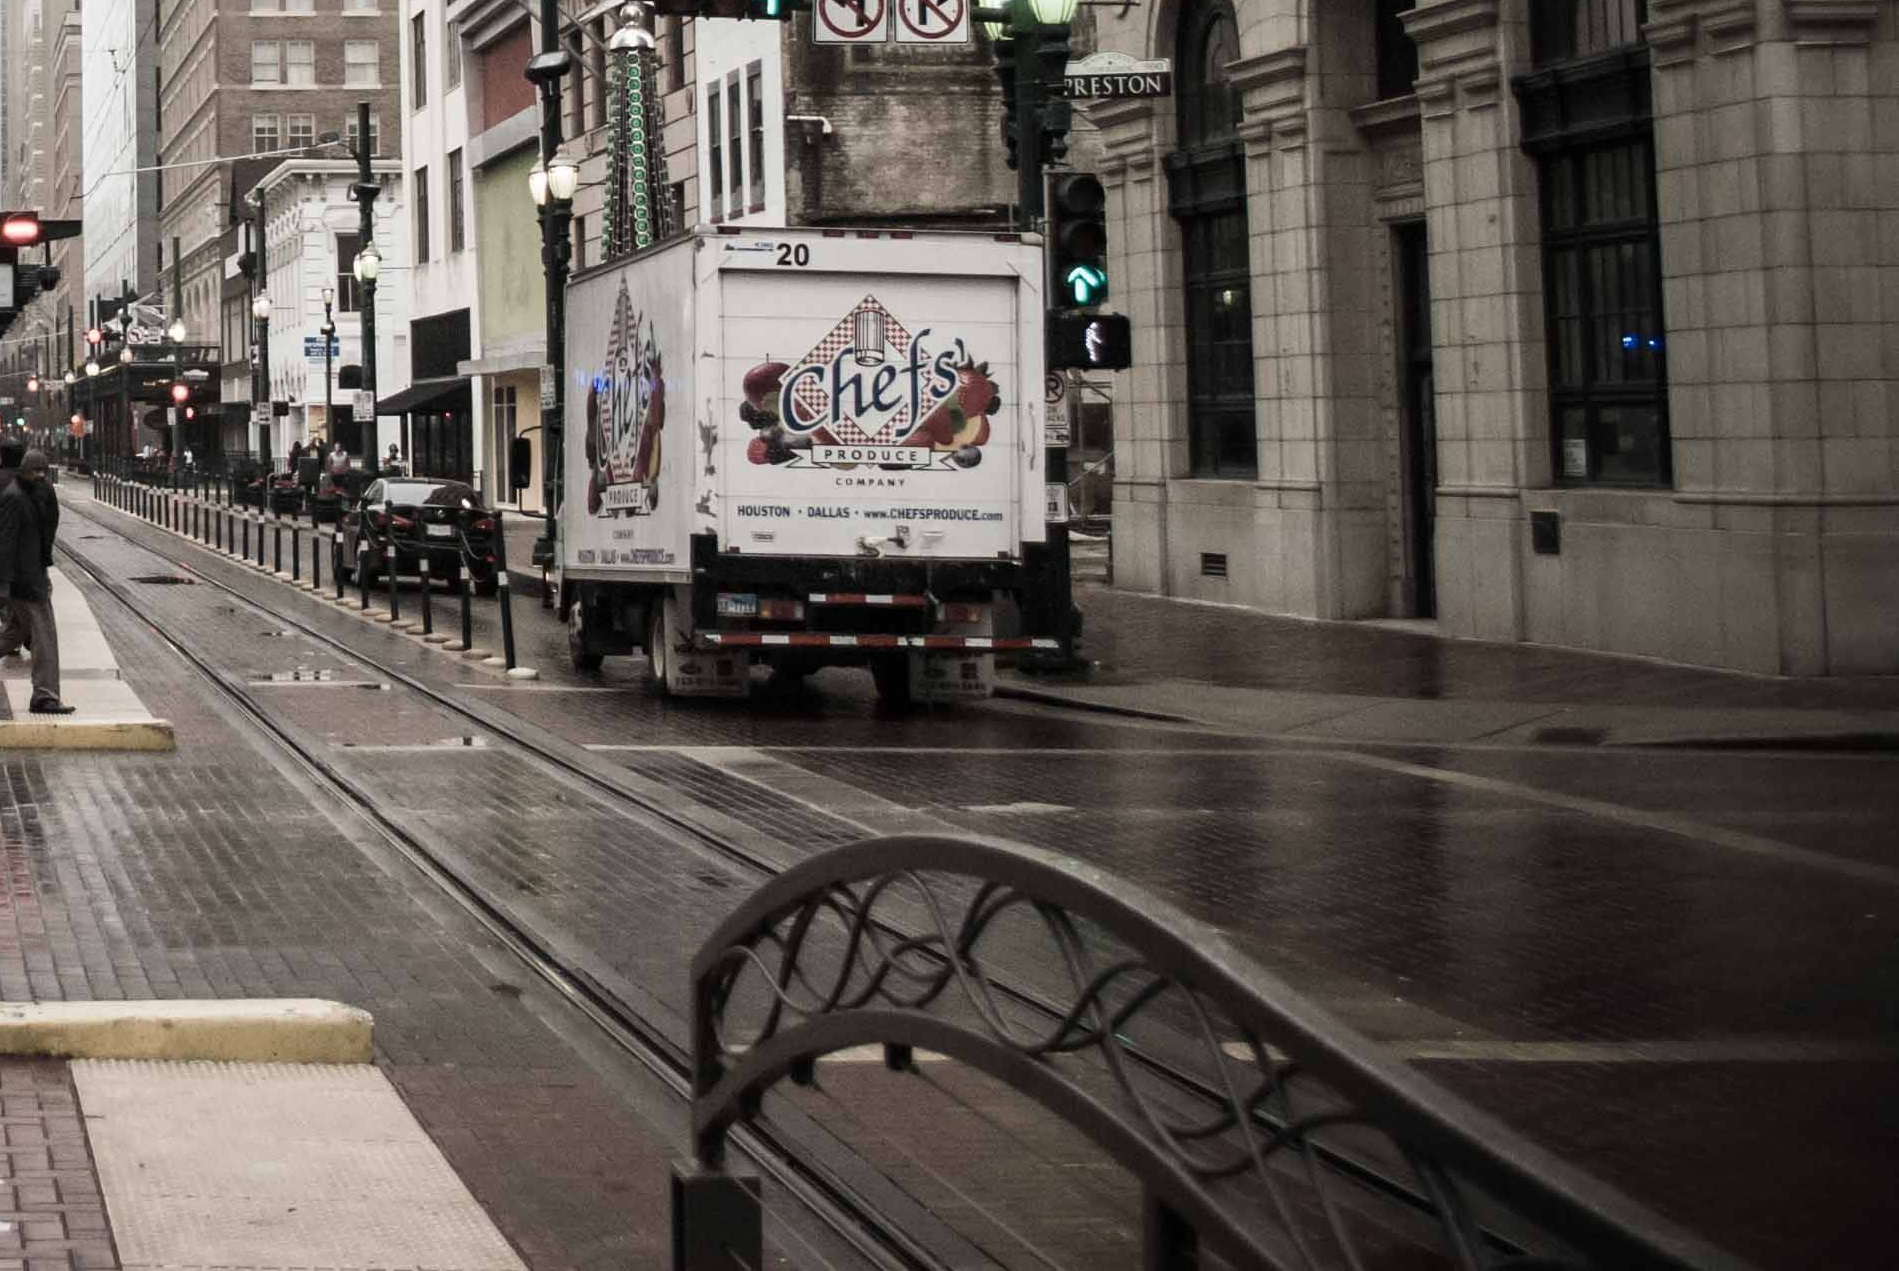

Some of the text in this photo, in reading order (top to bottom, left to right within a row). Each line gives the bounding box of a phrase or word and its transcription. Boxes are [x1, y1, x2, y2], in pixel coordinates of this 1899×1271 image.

[1064, 75, 1160, 96] PRESTON
[776, 243, 809, 266] 20
[782, 328, 966, 437] Chefs'
[824, 449, 918, 461] PRODUCE
[835, 477, 905, 486] COMPANY
[737, 505, 1003, 521] HOUSTON DALLAS www.CHEFSPRODUCE.com
